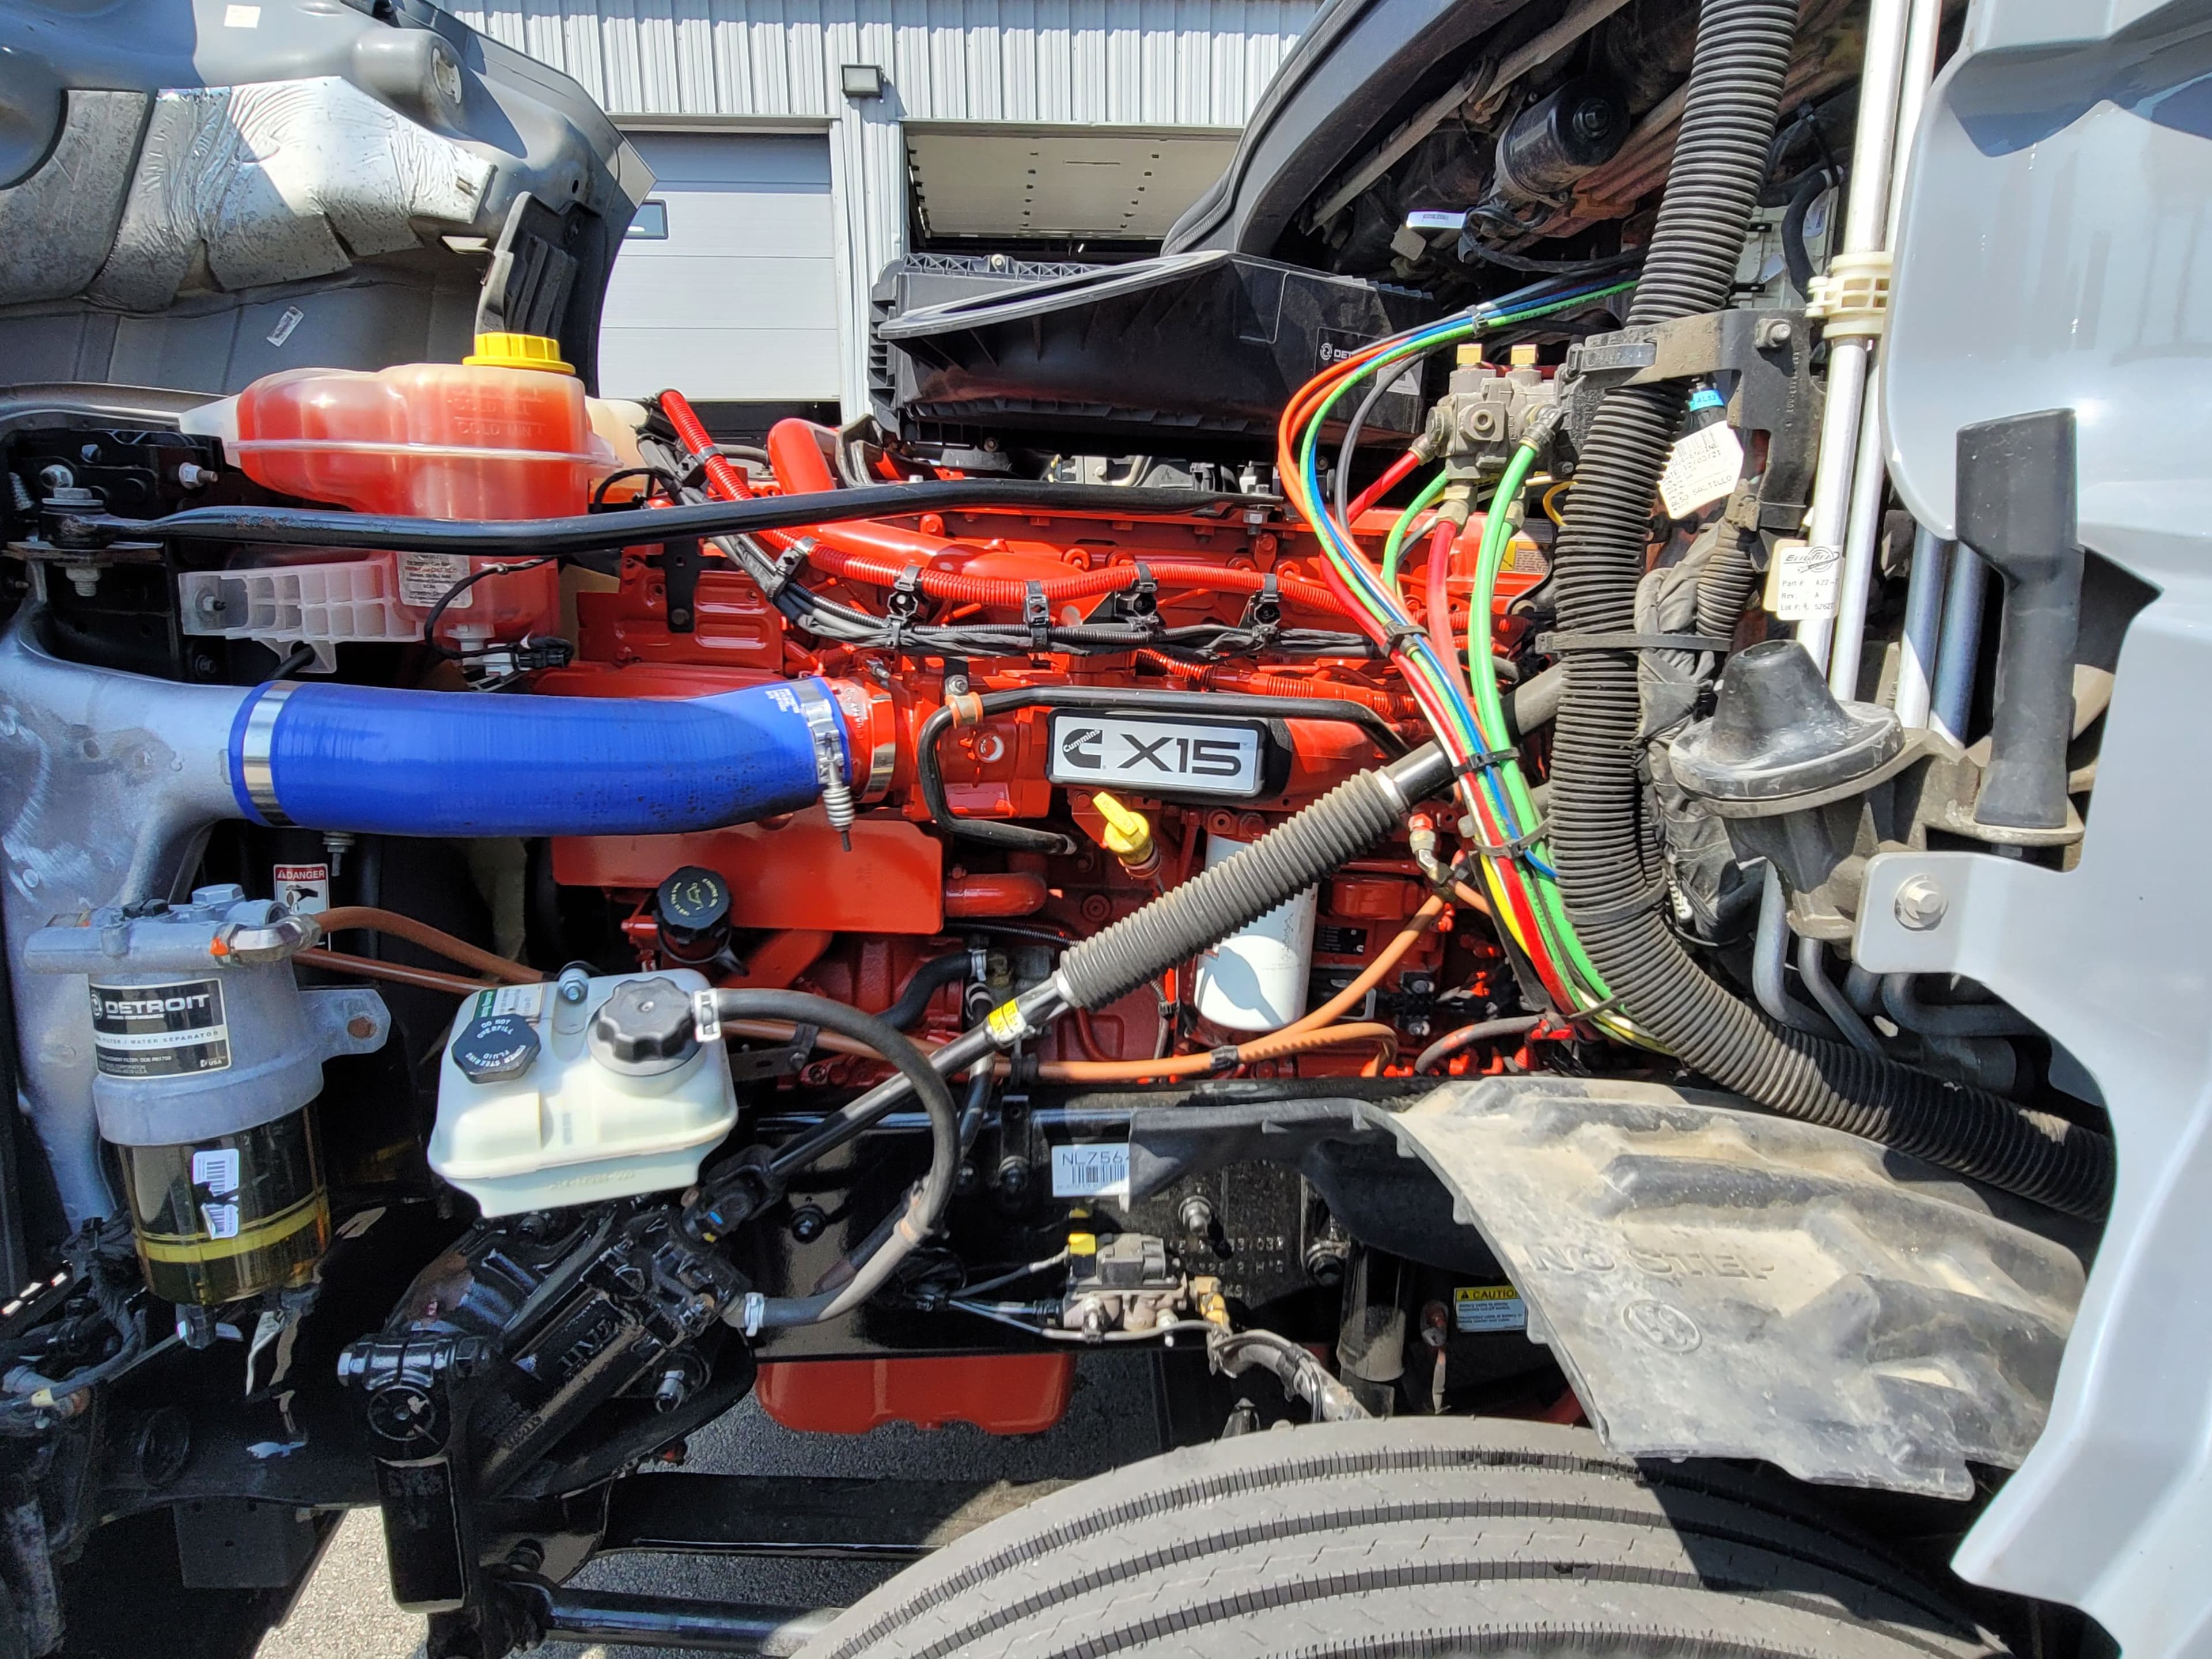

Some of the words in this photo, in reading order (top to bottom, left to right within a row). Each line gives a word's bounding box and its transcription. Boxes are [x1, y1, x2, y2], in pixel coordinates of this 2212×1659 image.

[1063, 729, 1100, 753] Cummins
[1116, 733, 1242, 777] X15
[286, 870, 325, 880] DANGER
[104, 994, 210, 1014] DETROIT
[481, 1021, 493, 1029] DO
[163, 1030, 219, 1043] SEPARATOR
[476, 1025, 514, 1039] OVERFILL
[483, 1050, 510, 1059] FLUID
[1524, 1246, 1615, 1271] NO
[1473, 1290, 1517, 1300] CAUTIO
